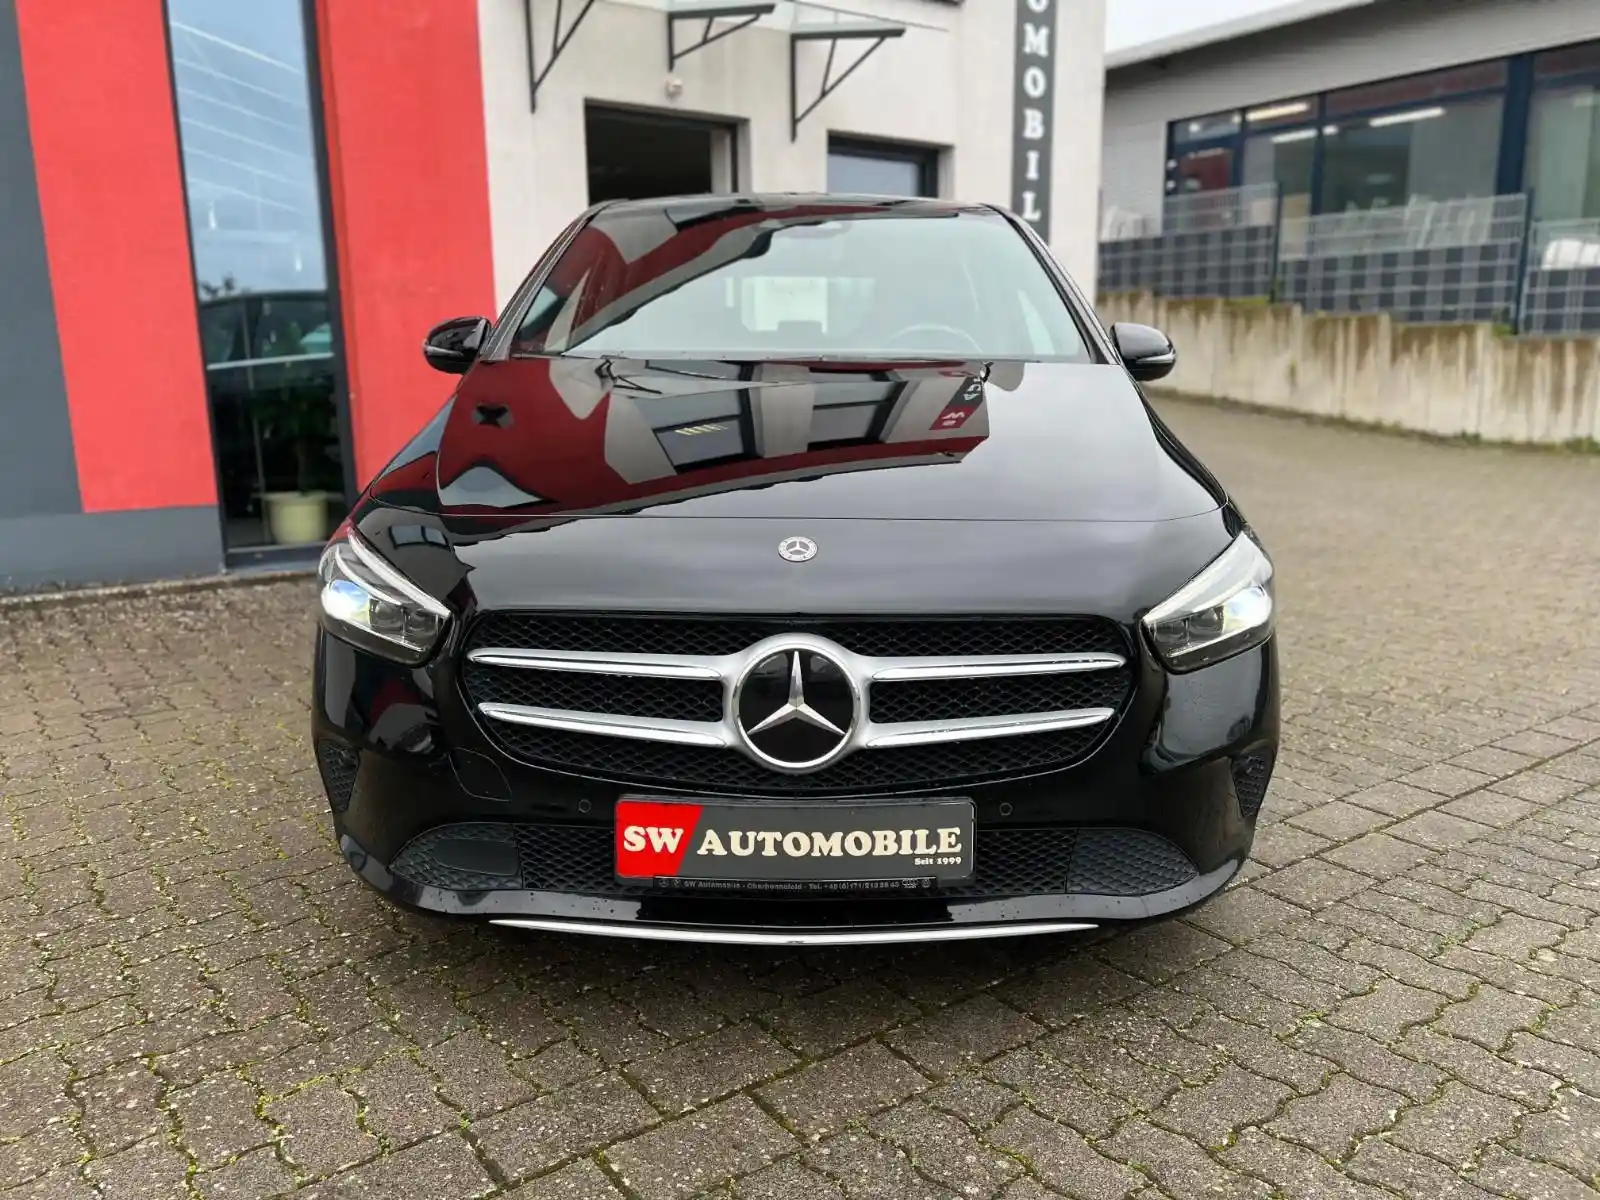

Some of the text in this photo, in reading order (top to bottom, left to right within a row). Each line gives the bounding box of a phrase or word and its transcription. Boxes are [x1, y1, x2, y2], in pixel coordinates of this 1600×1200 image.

[623, 825, 962, 857] SW AUTOMOBILE
[914, 856, 962, 866] Seit 1999
